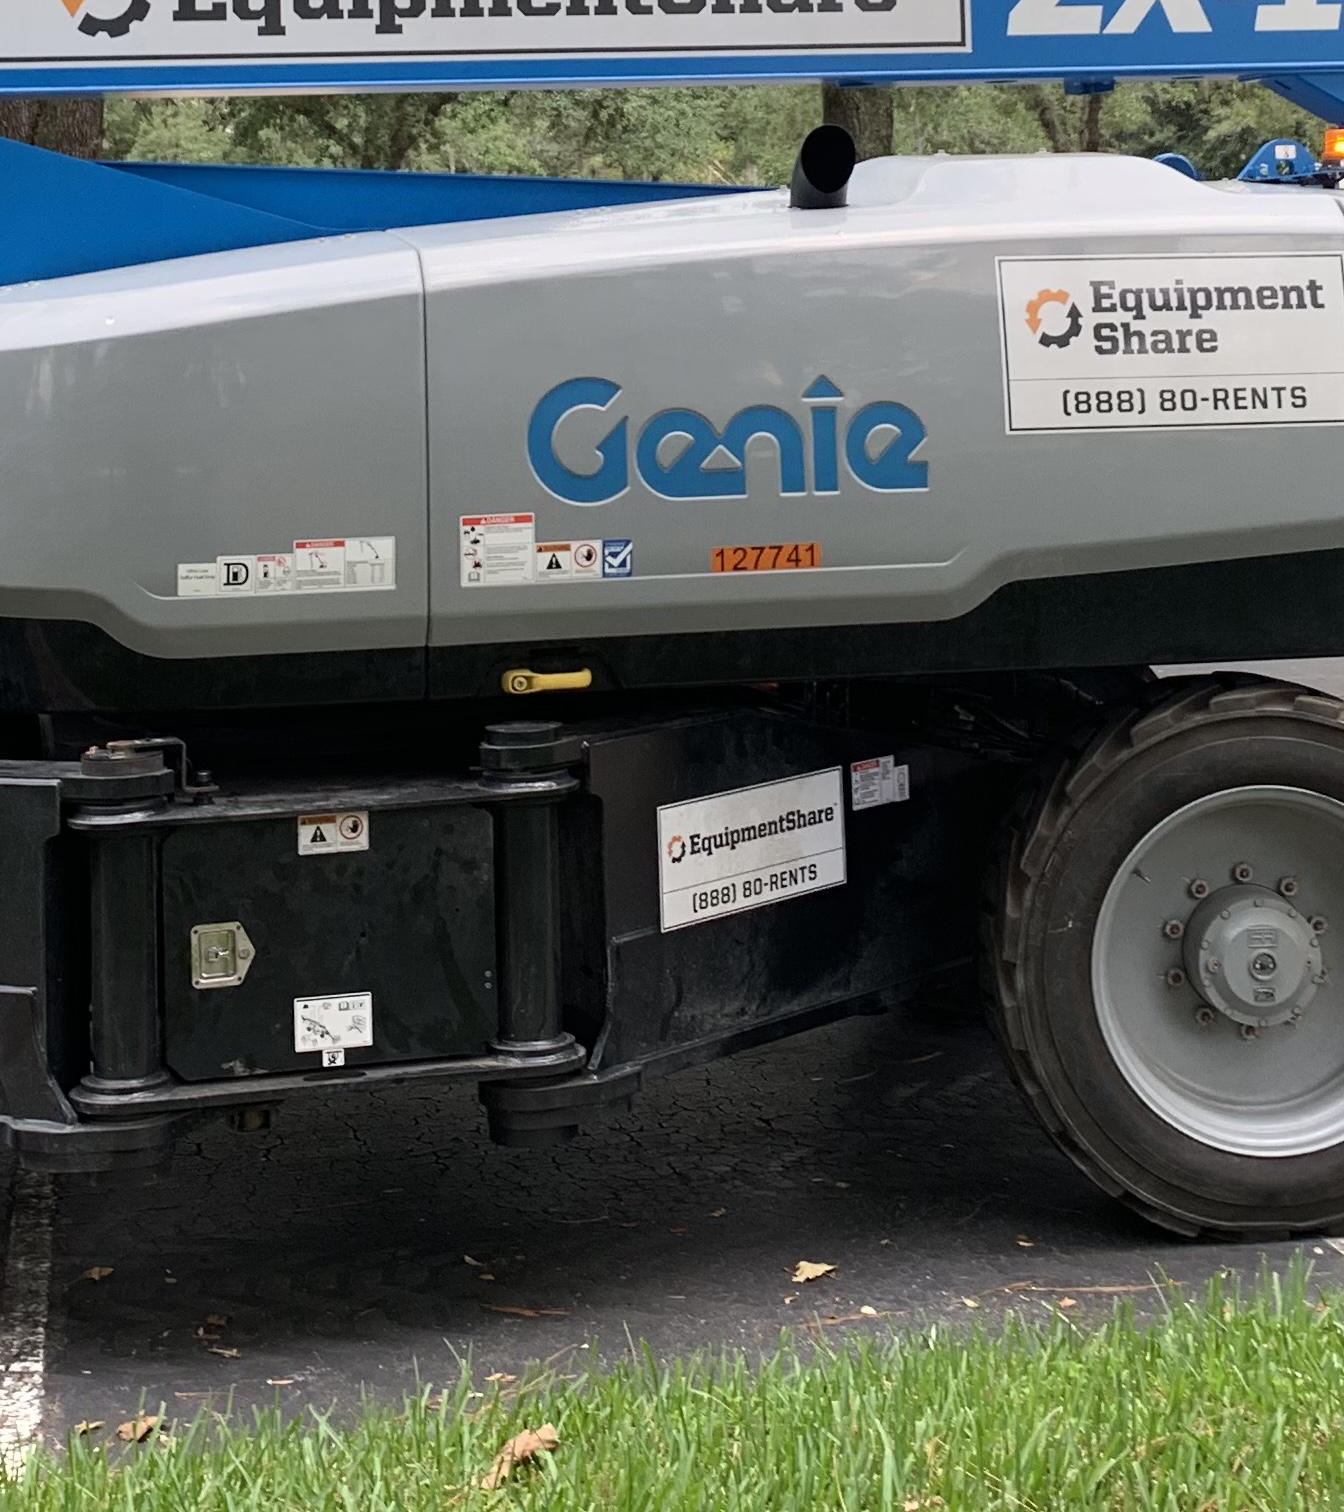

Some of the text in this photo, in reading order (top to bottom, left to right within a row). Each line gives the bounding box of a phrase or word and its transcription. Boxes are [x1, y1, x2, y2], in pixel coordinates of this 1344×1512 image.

[1088, 278, 1325, 320] Equipment
[1092, 321, 1219, 355] Share
[1062, 385, 1308, 416] (888) 80-RENTS
[526, 373, 930, 507] Genie
[714, 543, 819, 572] 127741
[688, 805, 835, 857] EquipmentShare
[692, 863, 818, 913] (888) 80-RENTS
